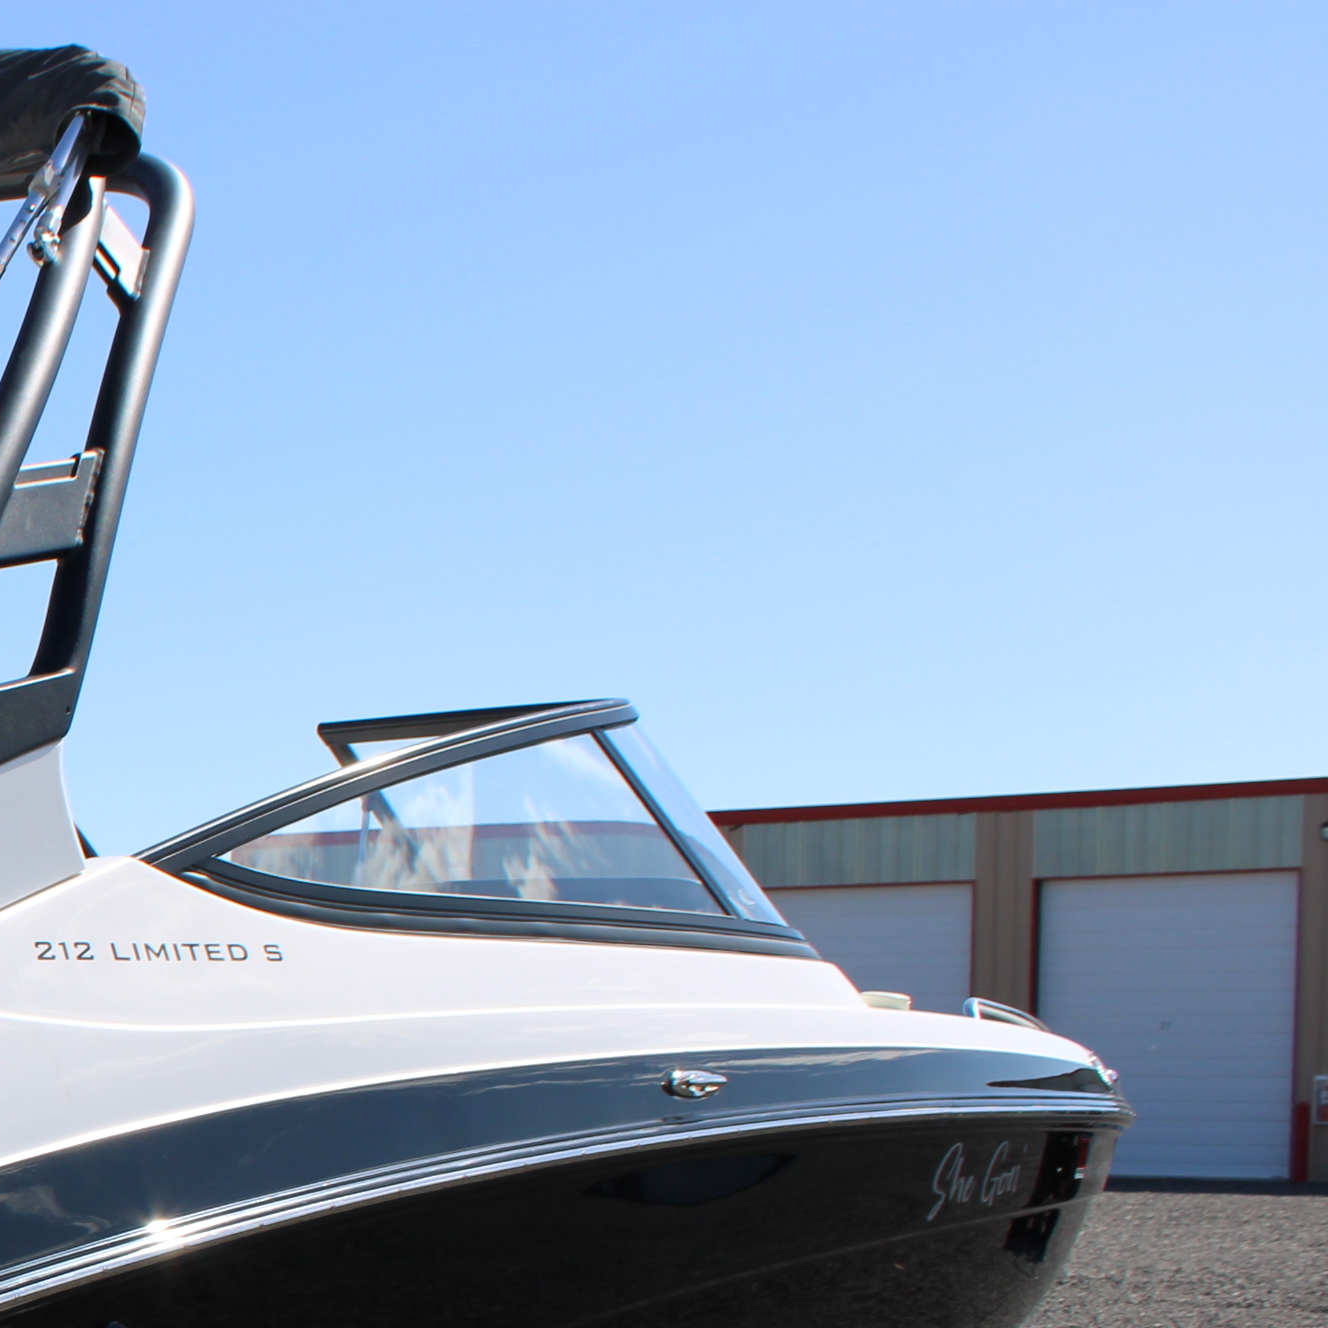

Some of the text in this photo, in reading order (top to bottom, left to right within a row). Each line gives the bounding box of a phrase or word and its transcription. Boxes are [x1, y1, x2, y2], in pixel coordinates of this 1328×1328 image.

[34, 941, 283, 962] 212 LIMITED S
[925, 1142, 978, 1222] She
